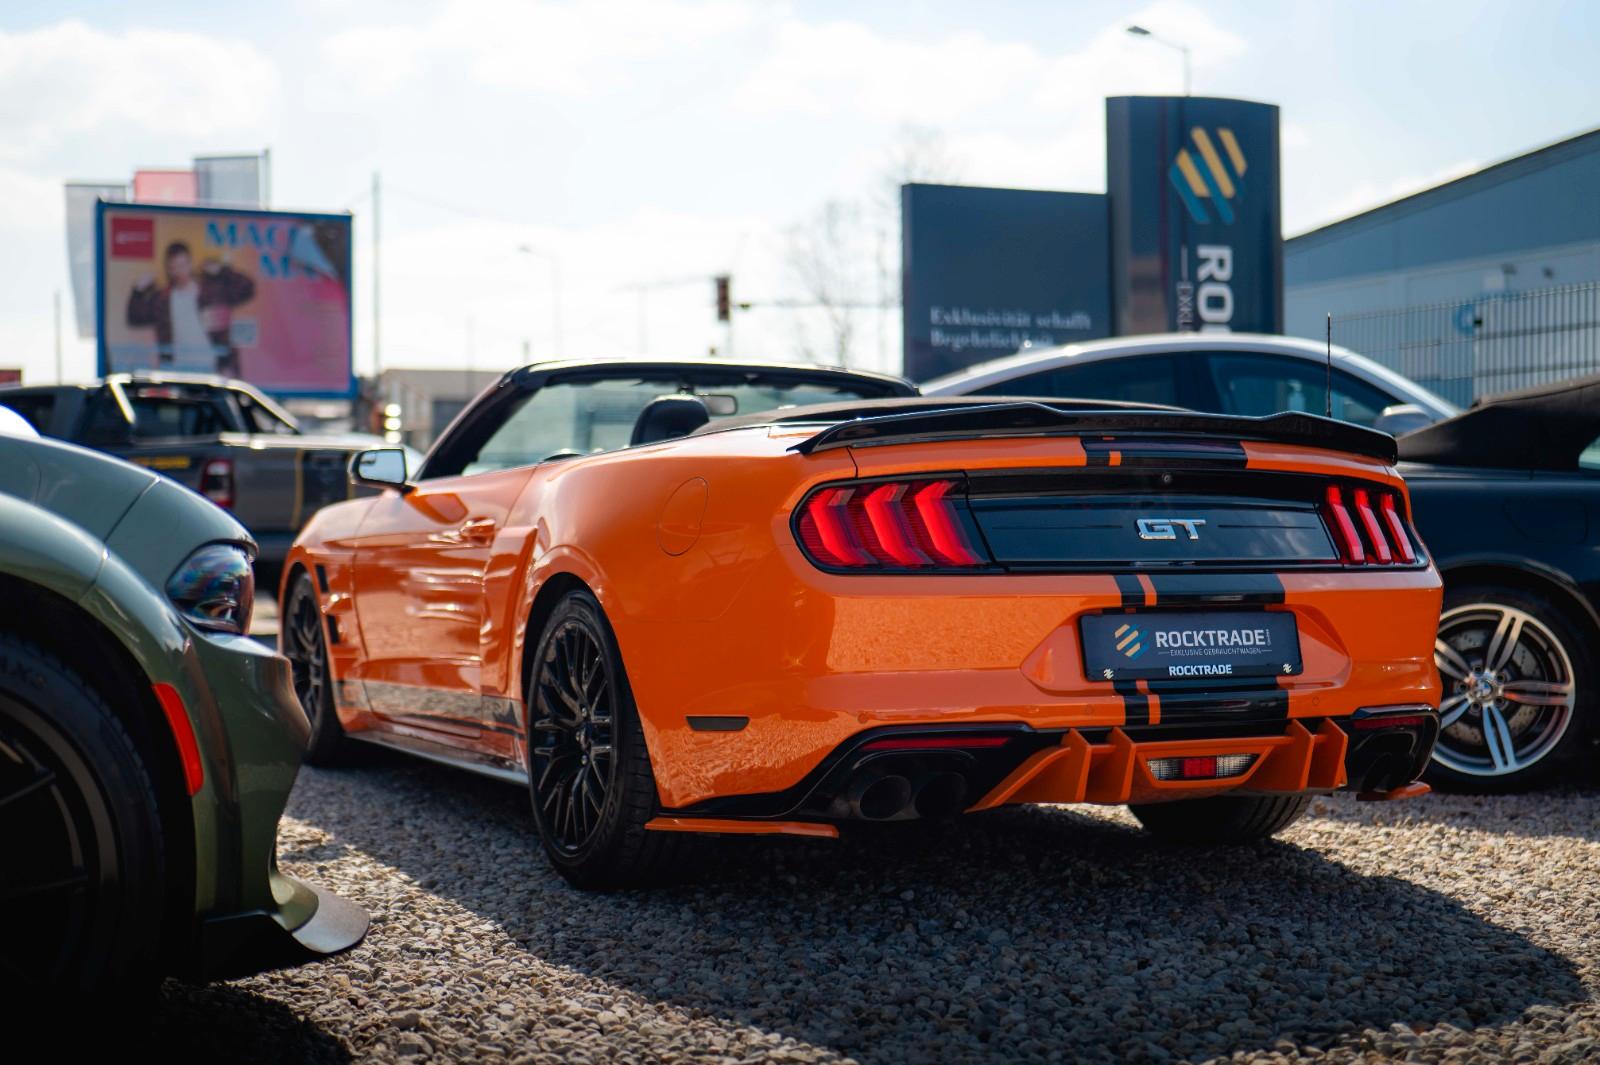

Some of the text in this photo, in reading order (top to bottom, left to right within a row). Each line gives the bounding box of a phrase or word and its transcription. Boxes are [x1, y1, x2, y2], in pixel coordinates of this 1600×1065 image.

[1197, 245, 1234, 333] RO
[1136, 519, 1206, 540] GT
[1155, 629, 1265, 648] ROCKTRADE
[1168, 664, 1233, 677] ROCKTRADE
